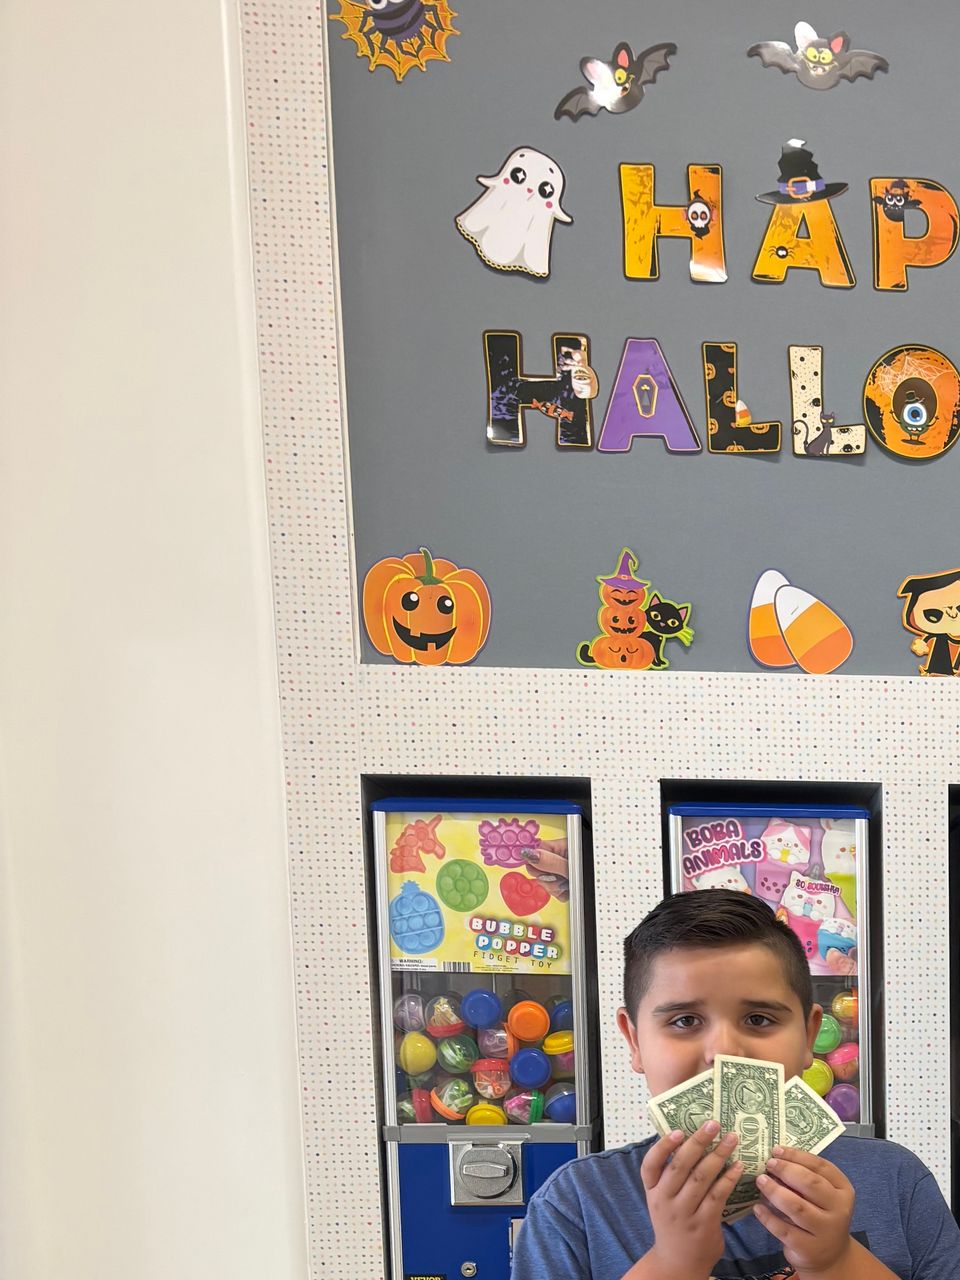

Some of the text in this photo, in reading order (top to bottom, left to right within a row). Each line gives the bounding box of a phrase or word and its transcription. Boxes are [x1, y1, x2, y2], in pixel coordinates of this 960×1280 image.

[685, 820, 740, 849] BOBA
[682, 840, 762, 876] ANIMALS
[795, 879, 806, 889] SO
[471, 917, 553, 942] BUBBLE
[477, 935, 559, 959] POPPER
[473, 951, 520, 965] FIDGET
[531, 960, 552, 969] TOY
